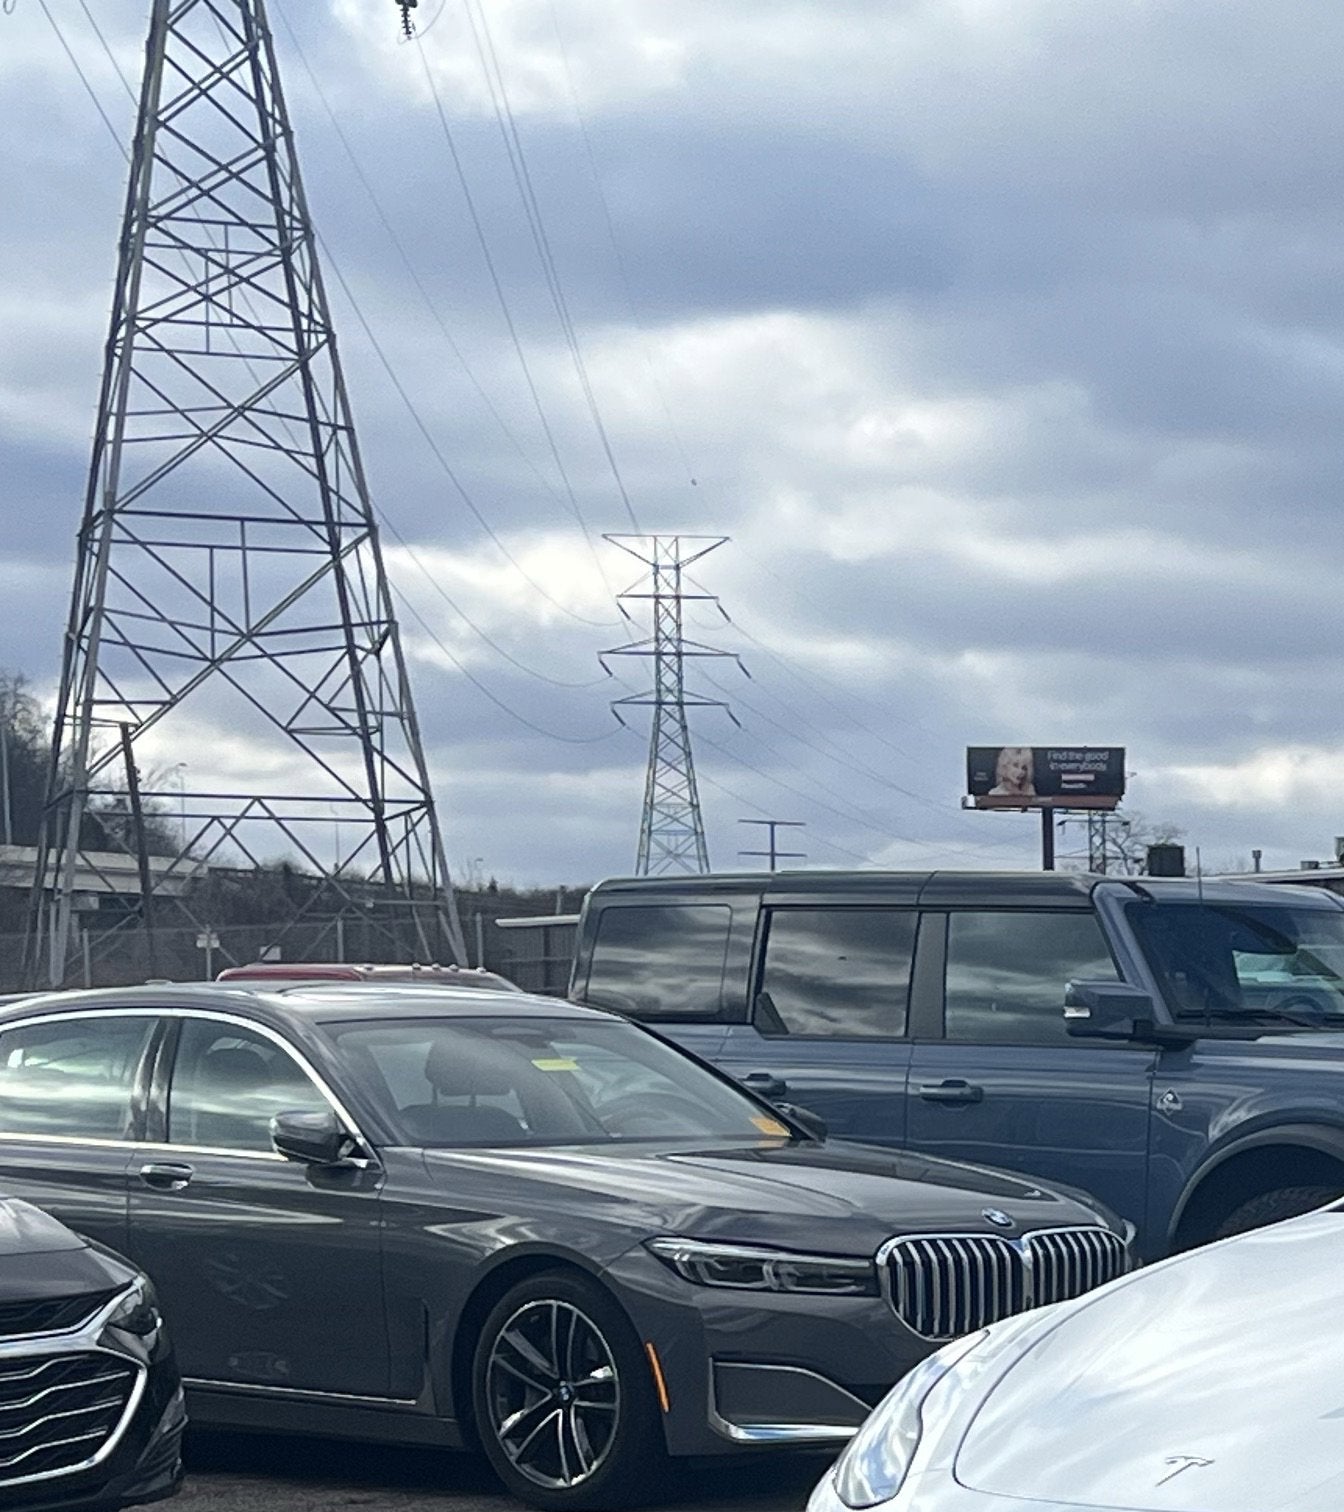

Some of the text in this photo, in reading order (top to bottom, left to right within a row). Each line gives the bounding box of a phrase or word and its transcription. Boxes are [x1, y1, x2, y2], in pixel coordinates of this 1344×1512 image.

[1047, 751, 1109, 763] Find the good
[1060, 762, 1107, 773] everybody
